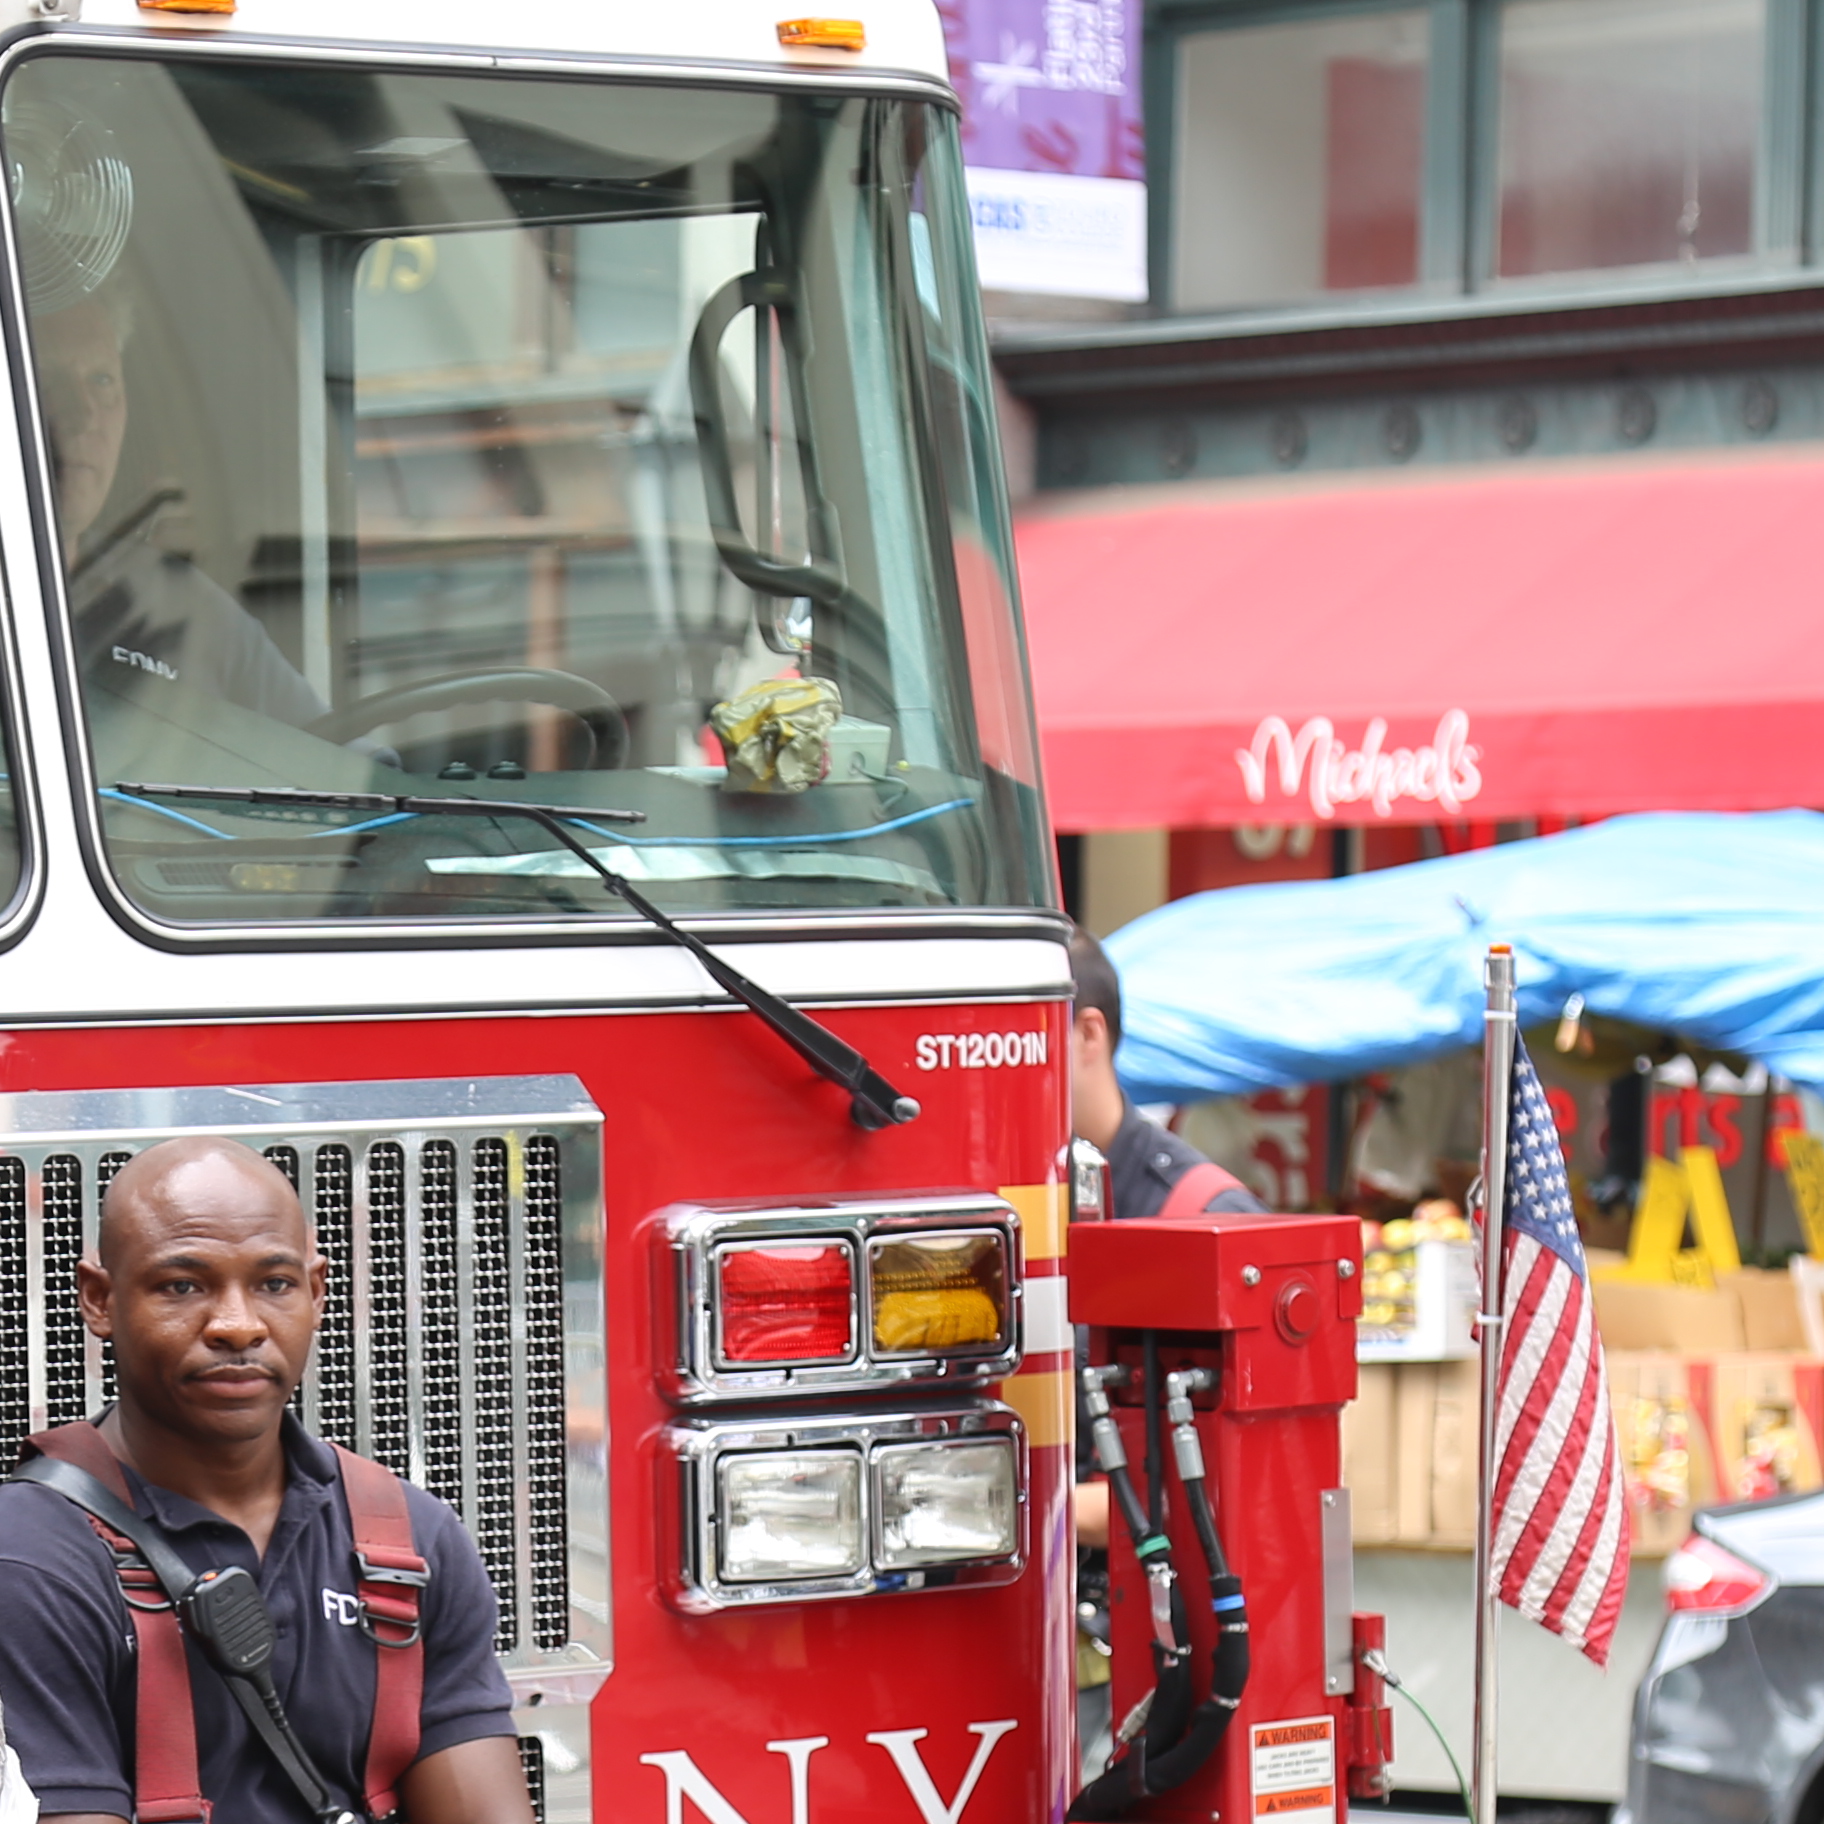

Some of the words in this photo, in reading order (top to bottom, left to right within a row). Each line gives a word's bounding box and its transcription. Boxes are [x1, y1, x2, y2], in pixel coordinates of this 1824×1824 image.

[1234, 707, 1483, 820] Michaels
[915, 1030, 1048, 1072] ST12001N
[322, 1588, 368, 1627] FD
[1273, 1724, 1327, 1743] WARNING
[1280, 1793, 1324, 1808] WARNING
